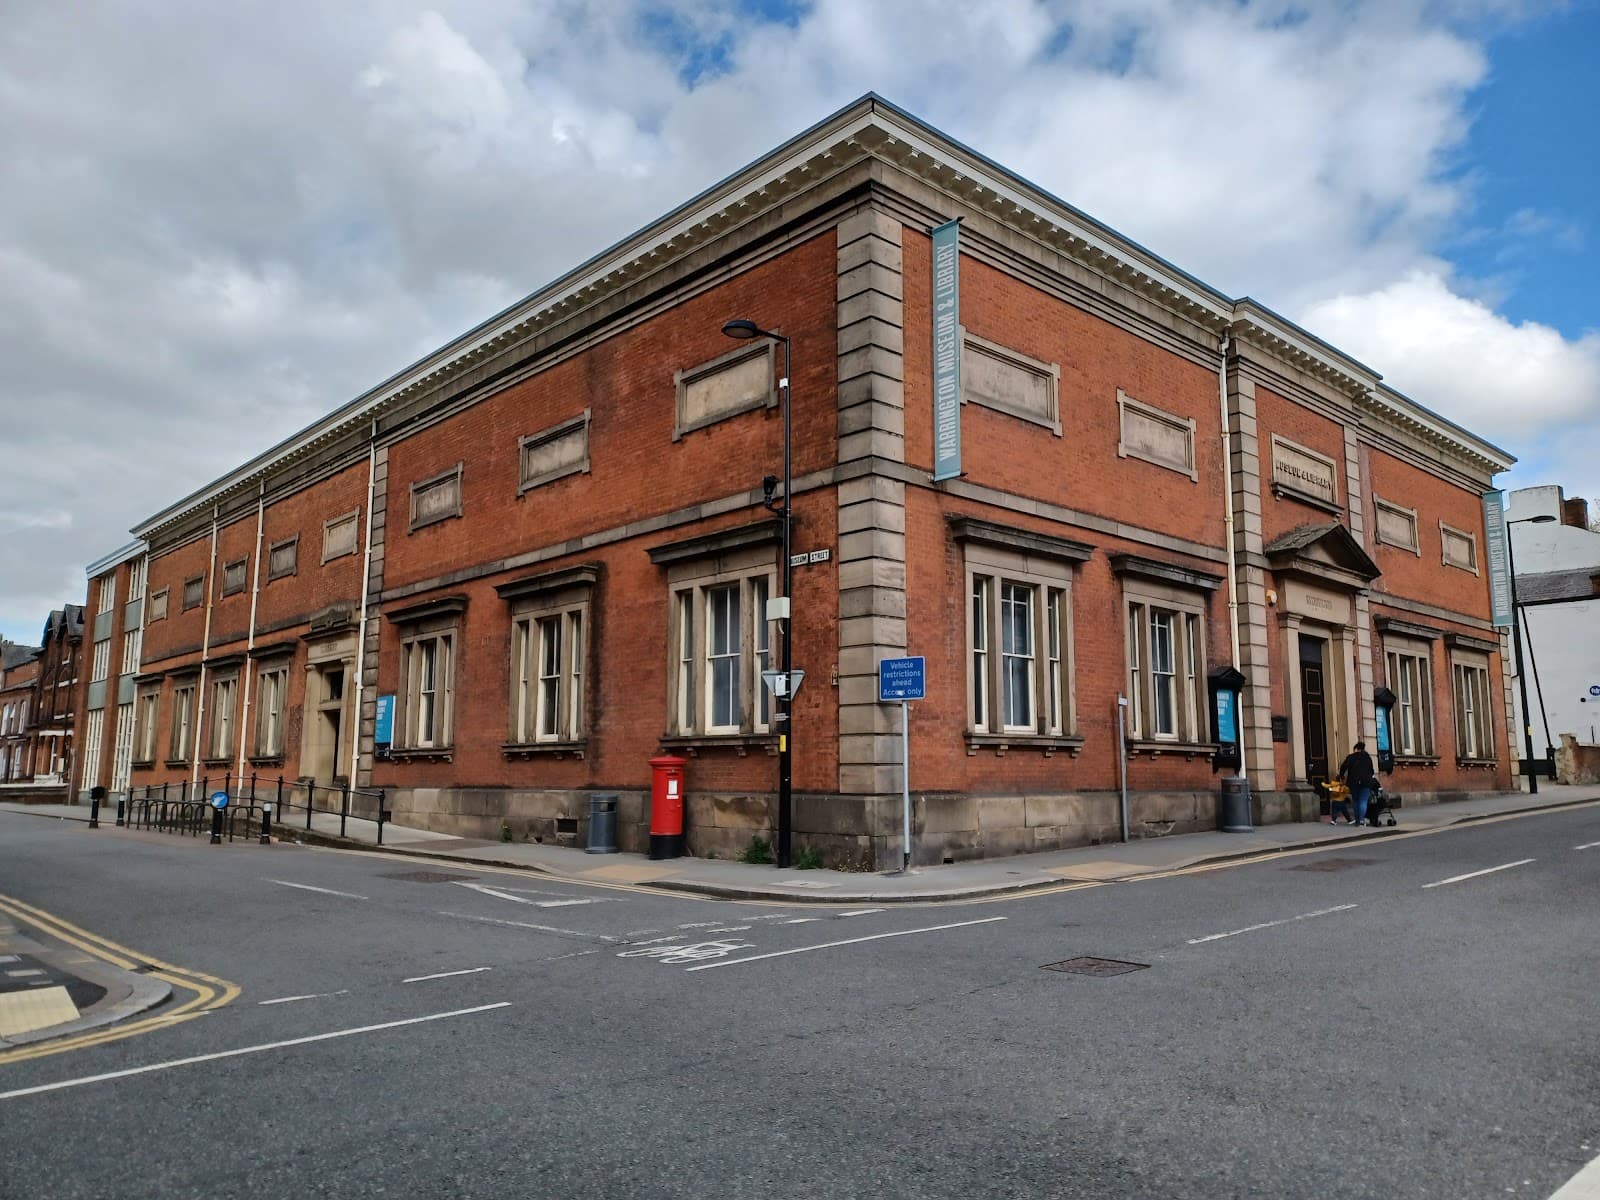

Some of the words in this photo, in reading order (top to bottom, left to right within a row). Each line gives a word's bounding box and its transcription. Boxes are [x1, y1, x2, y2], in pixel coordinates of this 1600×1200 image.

[937, 243, 954, 298] LIBRARY
[937, 297, 955, 311] &
[938, 311, 955, 374] MUSEUM
[938, 374, 956, 462] WARRINGTON
[890, 661, 914, 669] Vehicle
[883, 670, 921, 678] restrictions
[892, 678, 912, 686] ahead
[907, 688, 922, 696] only
